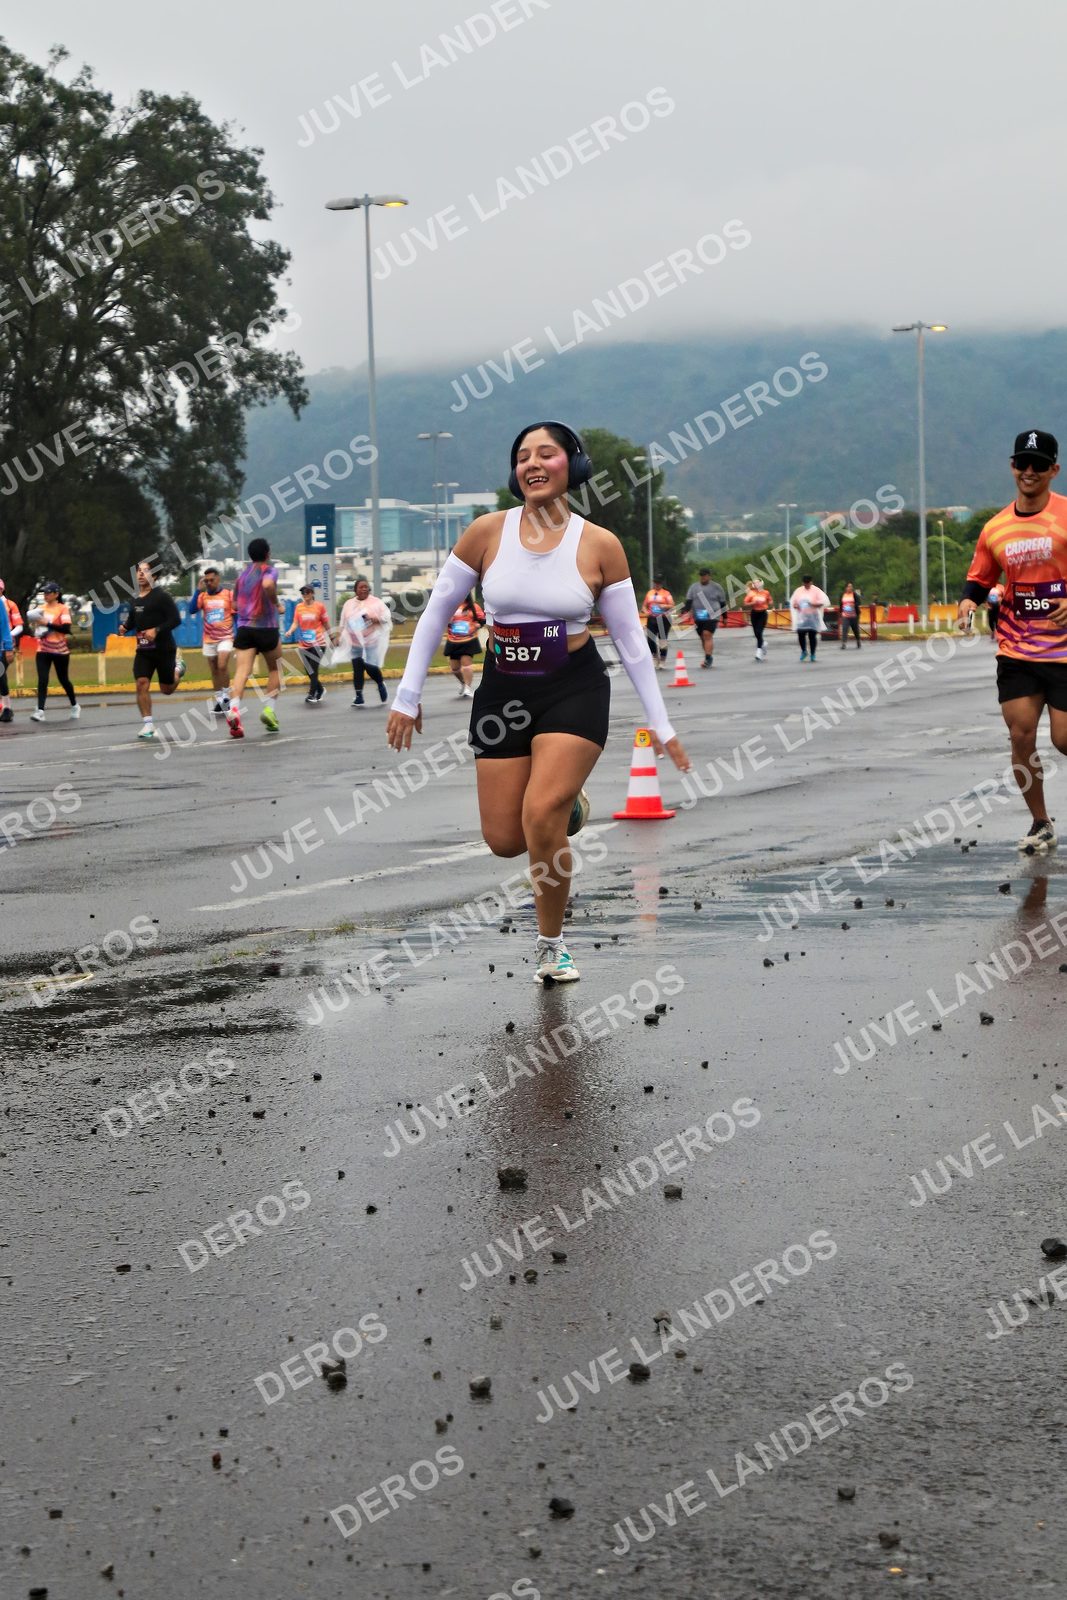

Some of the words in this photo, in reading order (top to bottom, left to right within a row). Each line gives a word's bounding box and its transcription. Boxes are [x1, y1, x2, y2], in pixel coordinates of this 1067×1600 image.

[311, 525, 328, 547] E
[1005, 537, 1052, 556] CARRERA
[1024, 598, 1050, 610] 596
[544, 626, 560, 638] 15K
[505, 646, 541, 662] 587
